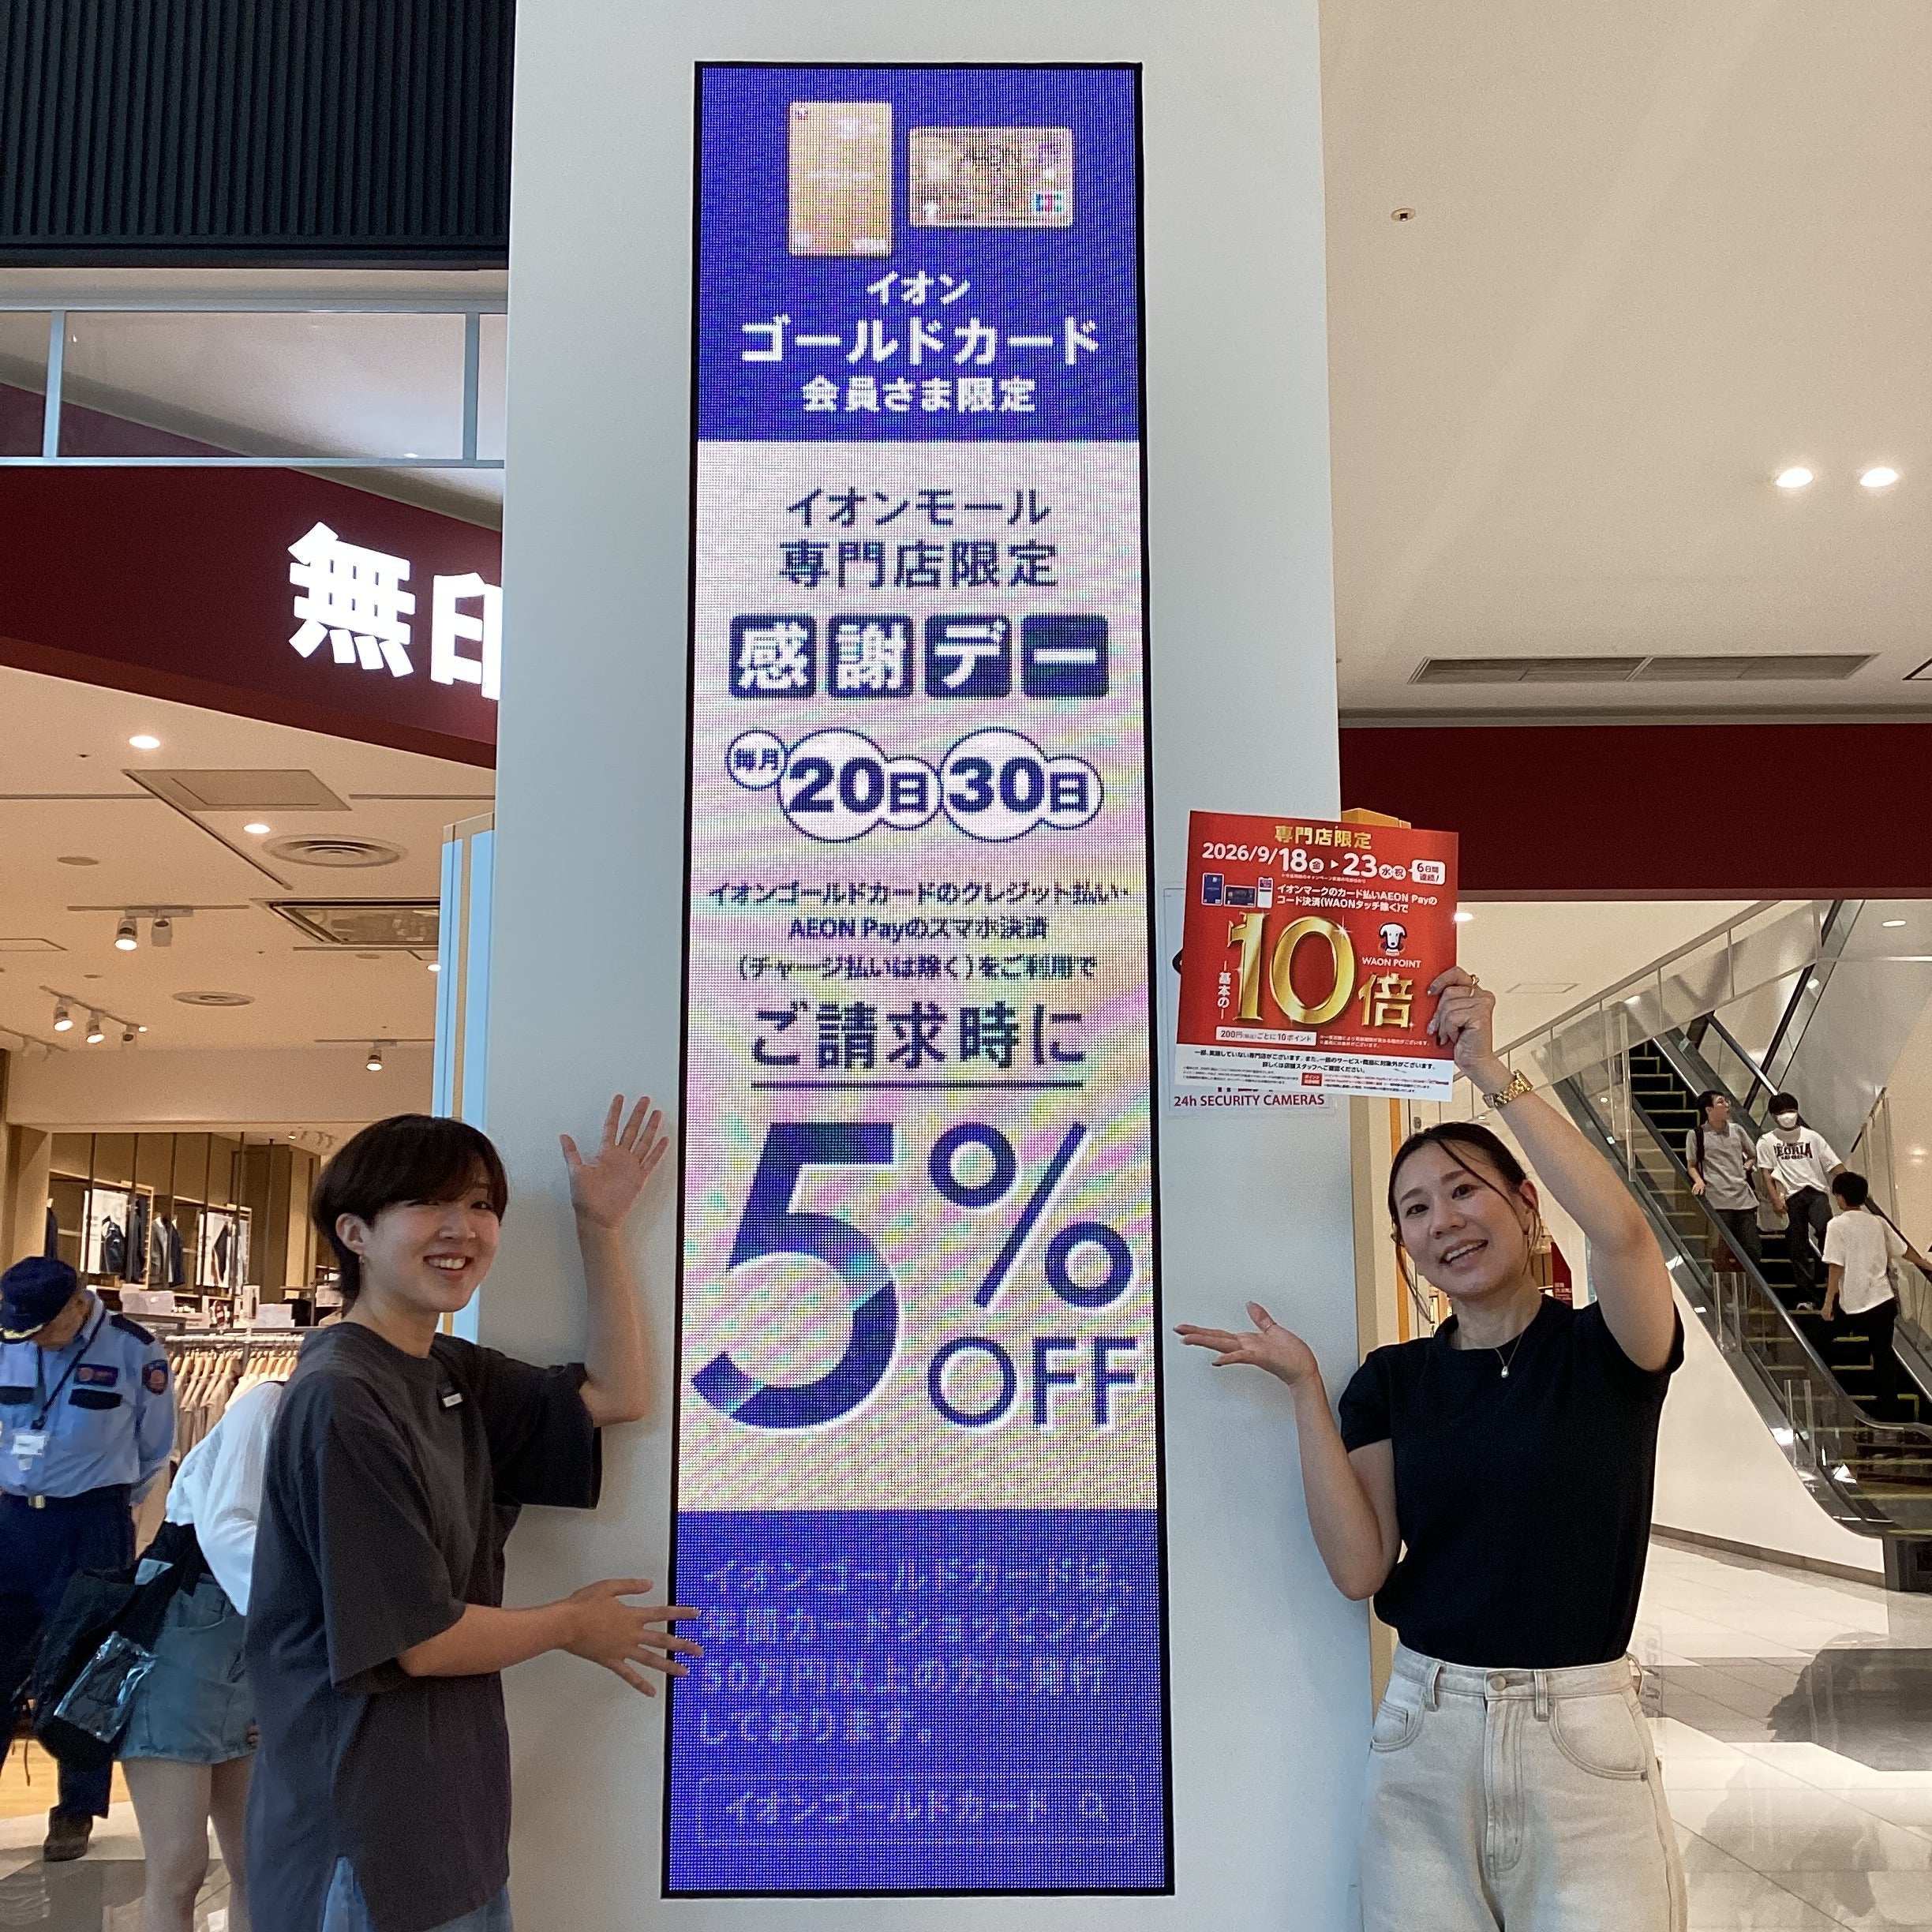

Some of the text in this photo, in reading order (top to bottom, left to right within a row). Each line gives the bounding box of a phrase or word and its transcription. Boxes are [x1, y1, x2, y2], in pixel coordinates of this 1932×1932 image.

[867, 271, 971, 305] イオン
[741, 314, 1100, 365] ゴールドカード
[801, 375, 1036, 413] 会員さま限定
[787, 487, 1052, 526] イオンモール
[778, 540, 1058, 588] 専門店限定
[736, 619, 1098, 691] 感謝デー
[733, 747, 781, 771] 毎月
[1274, 825, 1372, 851] 専門店限定
[1361, 957, 1422, 968] WAON POINT
[751, 1001, 1085, 1070] ご請求時に
[1174, 1094, 1325, 1106] 24h SECURITY CAMERAS
[927, 1336, 1139, 1428] OFF
[698, 1708, 934, 1747] しております。
